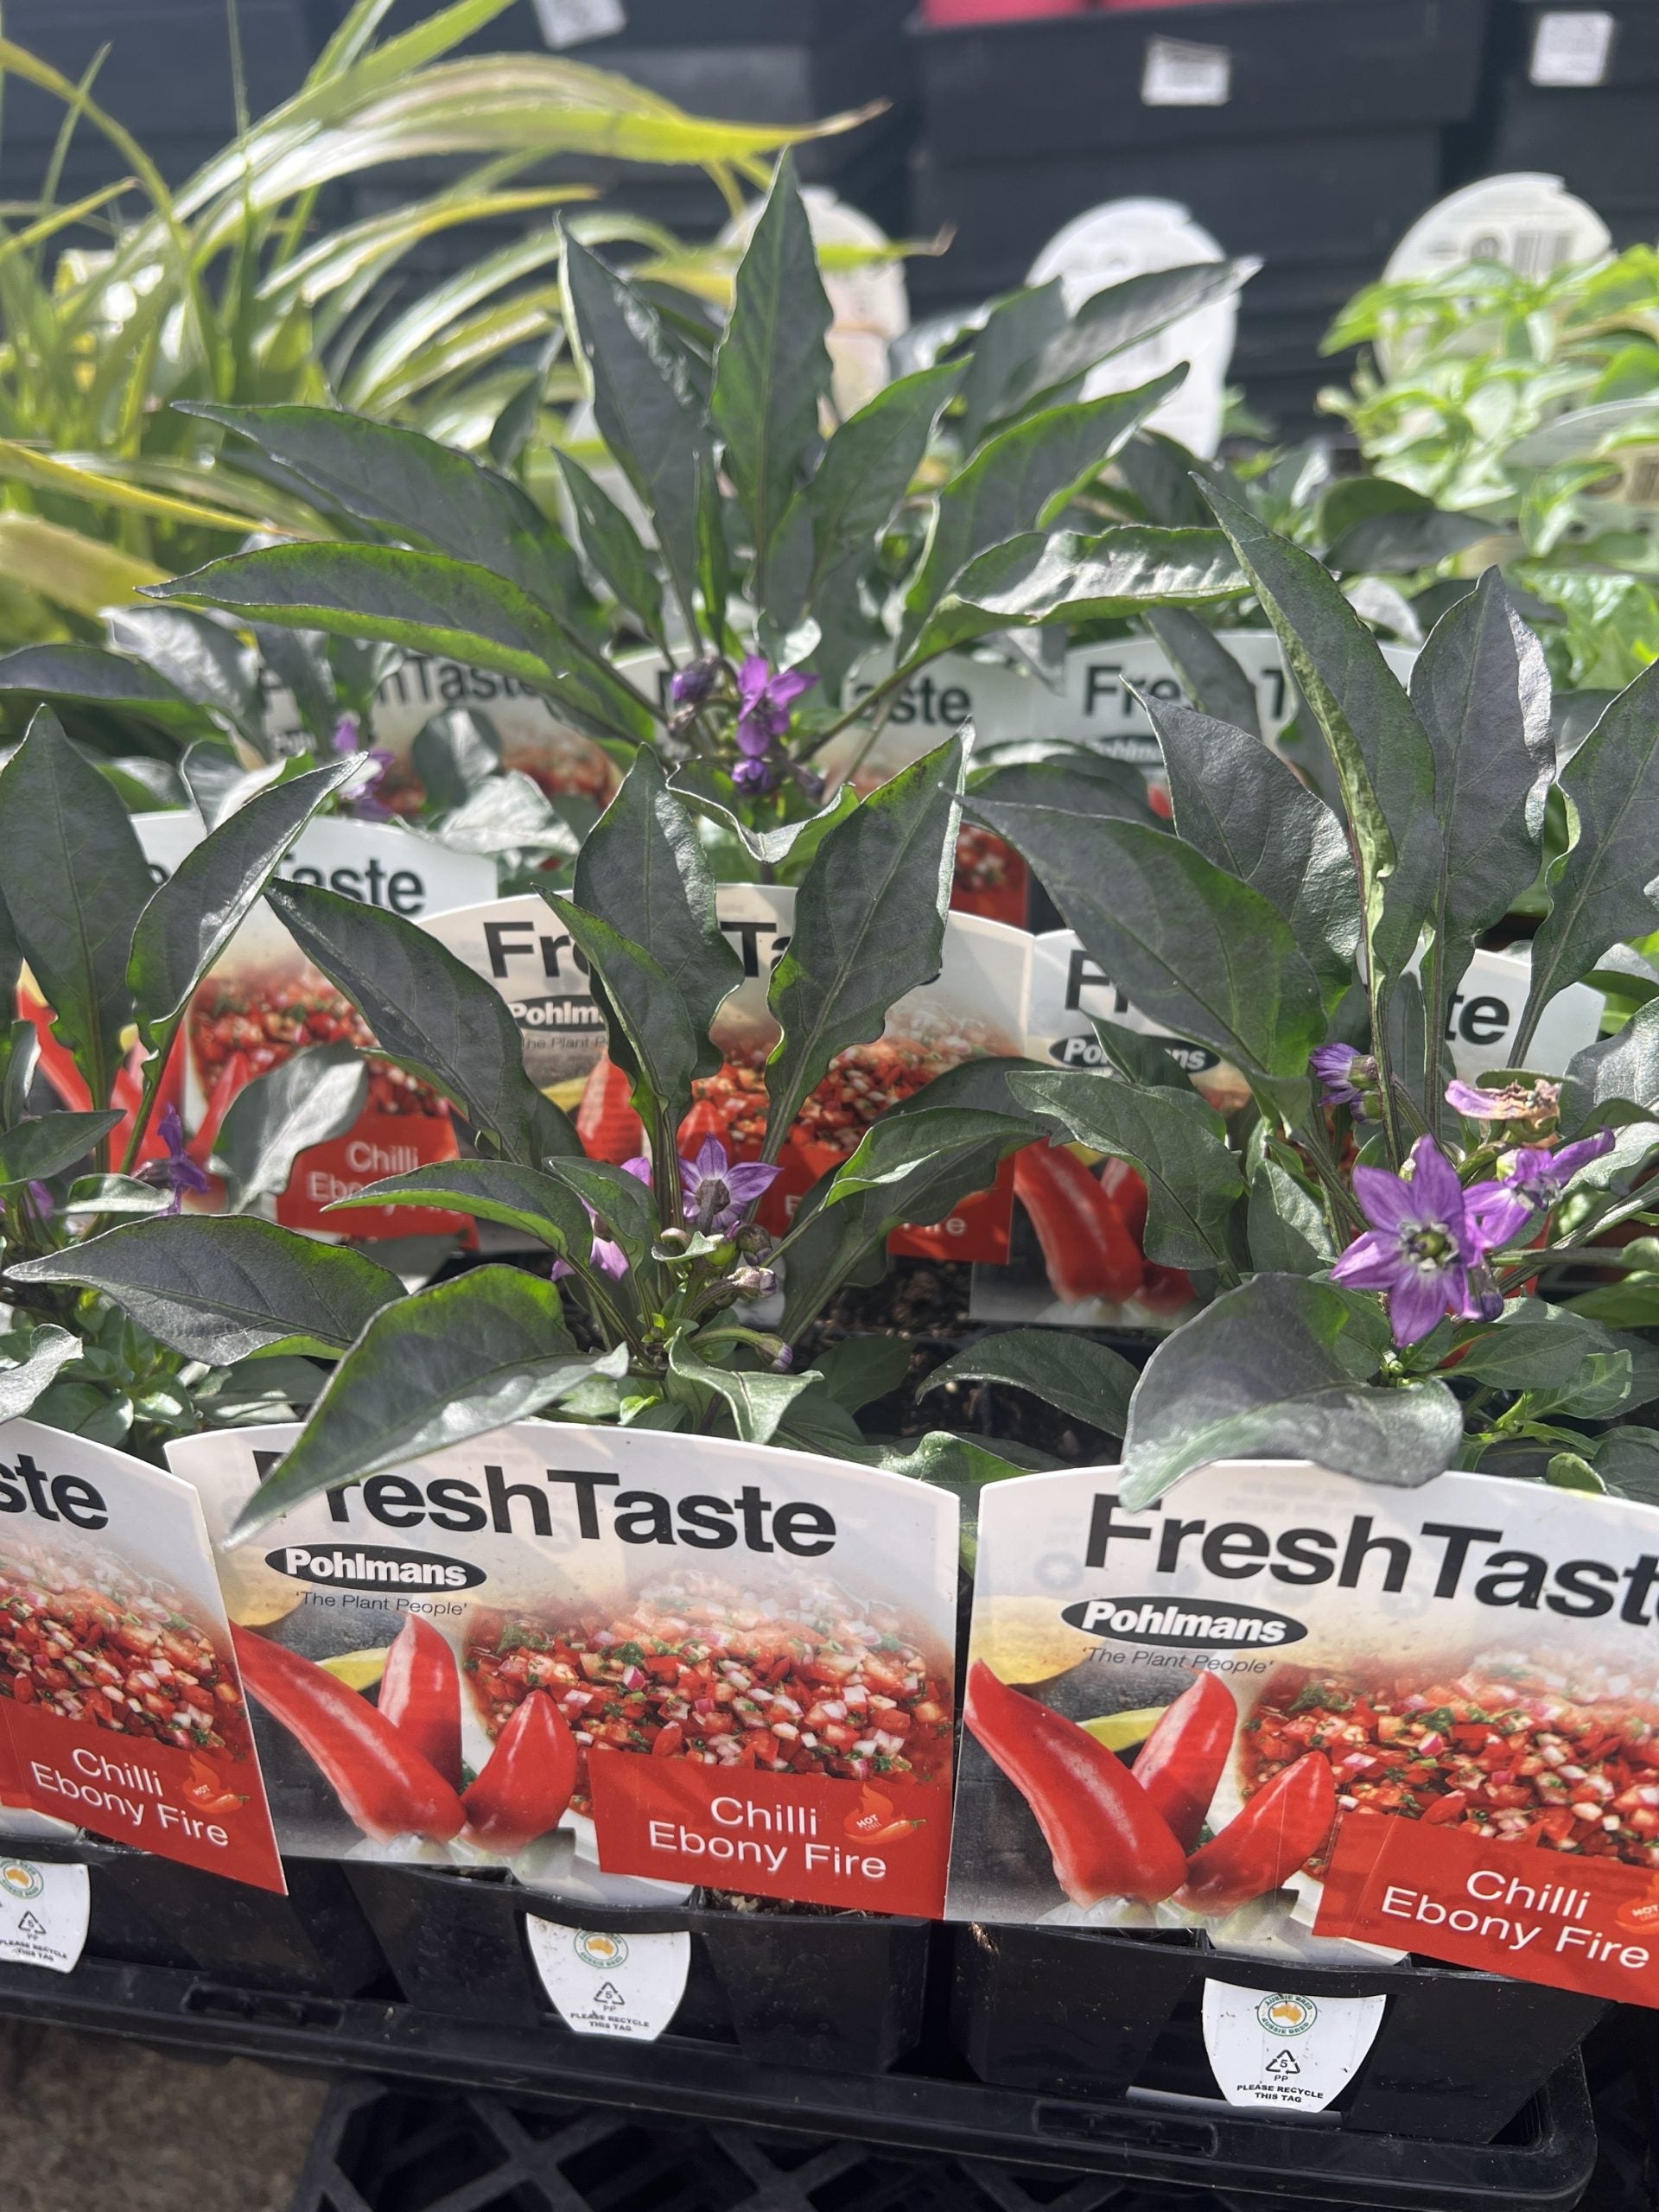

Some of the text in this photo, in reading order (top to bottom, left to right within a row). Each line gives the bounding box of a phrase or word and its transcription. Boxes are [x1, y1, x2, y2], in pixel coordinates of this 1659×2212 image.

[507, 1001, 604, 1027] Pohlm
[347, 1141, 418, 1173] Chilli
[285, 1548, 467, 1587] Pohlmans
[1084, 1491, 1659, 1627] FreshTast
[342, 1594, 390, 1611] Plant
[1081, 1600, 1287, 1643] Pohlmans
[1131, 1649, 1185, 1669] Plant
[72, 1747, 163, 1797] Chilli
[30, 1760, 230, 1847] Ebony Fire
[710, 1796, 817, 1836] Chilli
[855, 1813, 879, 1828] HOT
[648, 1820, 887, 1879] Ebony Fire
[1465, 1869, 1592, 1920] Chilli
[1381, 1885, 1650, 1969] Ebony Fire
[605, 1990, 613, 1999] 5
[570, 2012, 650, 2027] PLEASE RECYCLE
[588, 2020, 632, 2031] THIS TAG
[1262, 2017, 1310, 2034] AUSSIE BRED
[1280, 2059, 1288, 2069] 5
[1255, 2092, 1302, 2103] THIS TAG
[1277, 2086, 1324, 2100] RECYCLE
